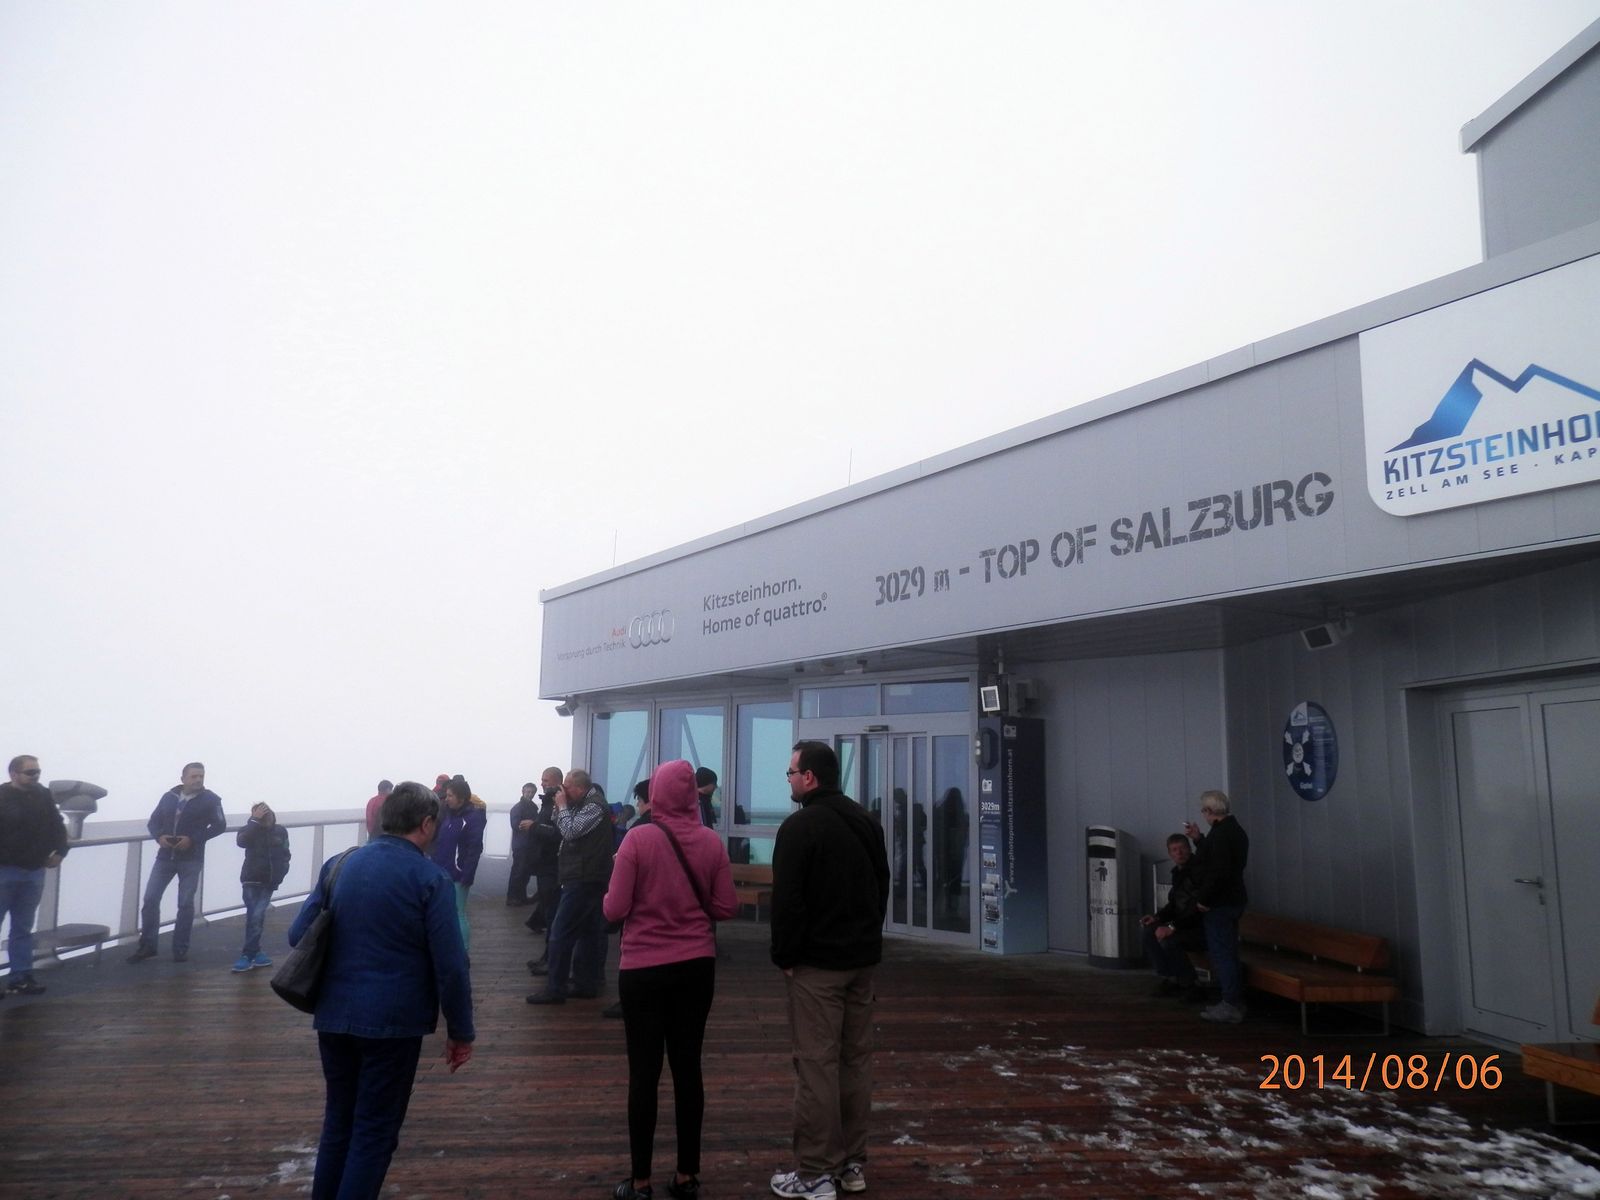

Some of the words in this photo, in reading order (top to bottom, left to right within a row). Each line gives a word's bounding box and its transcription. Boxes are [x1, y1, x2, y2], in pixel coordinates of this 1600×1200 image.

[1386, 483, 1429, 500] ZELL
[1441, 474, 1469, 489] AM
[1483, 463, 1519, 480] SEE
[1554, 447, 1598, 465] KAP
[875, 565, 925, 606] 3029
[934, 568, 950, 593] m
[978, 538, 1040, 584] TOP
[1050, 524, 1098, 568] OF
[1109, 471, 1335, 557] SALZBURG
[702, 577, 802, 612] Kitzsteinhorn.
[702, 614, 742, 635] Home
[745, 607, 760, 627] of
